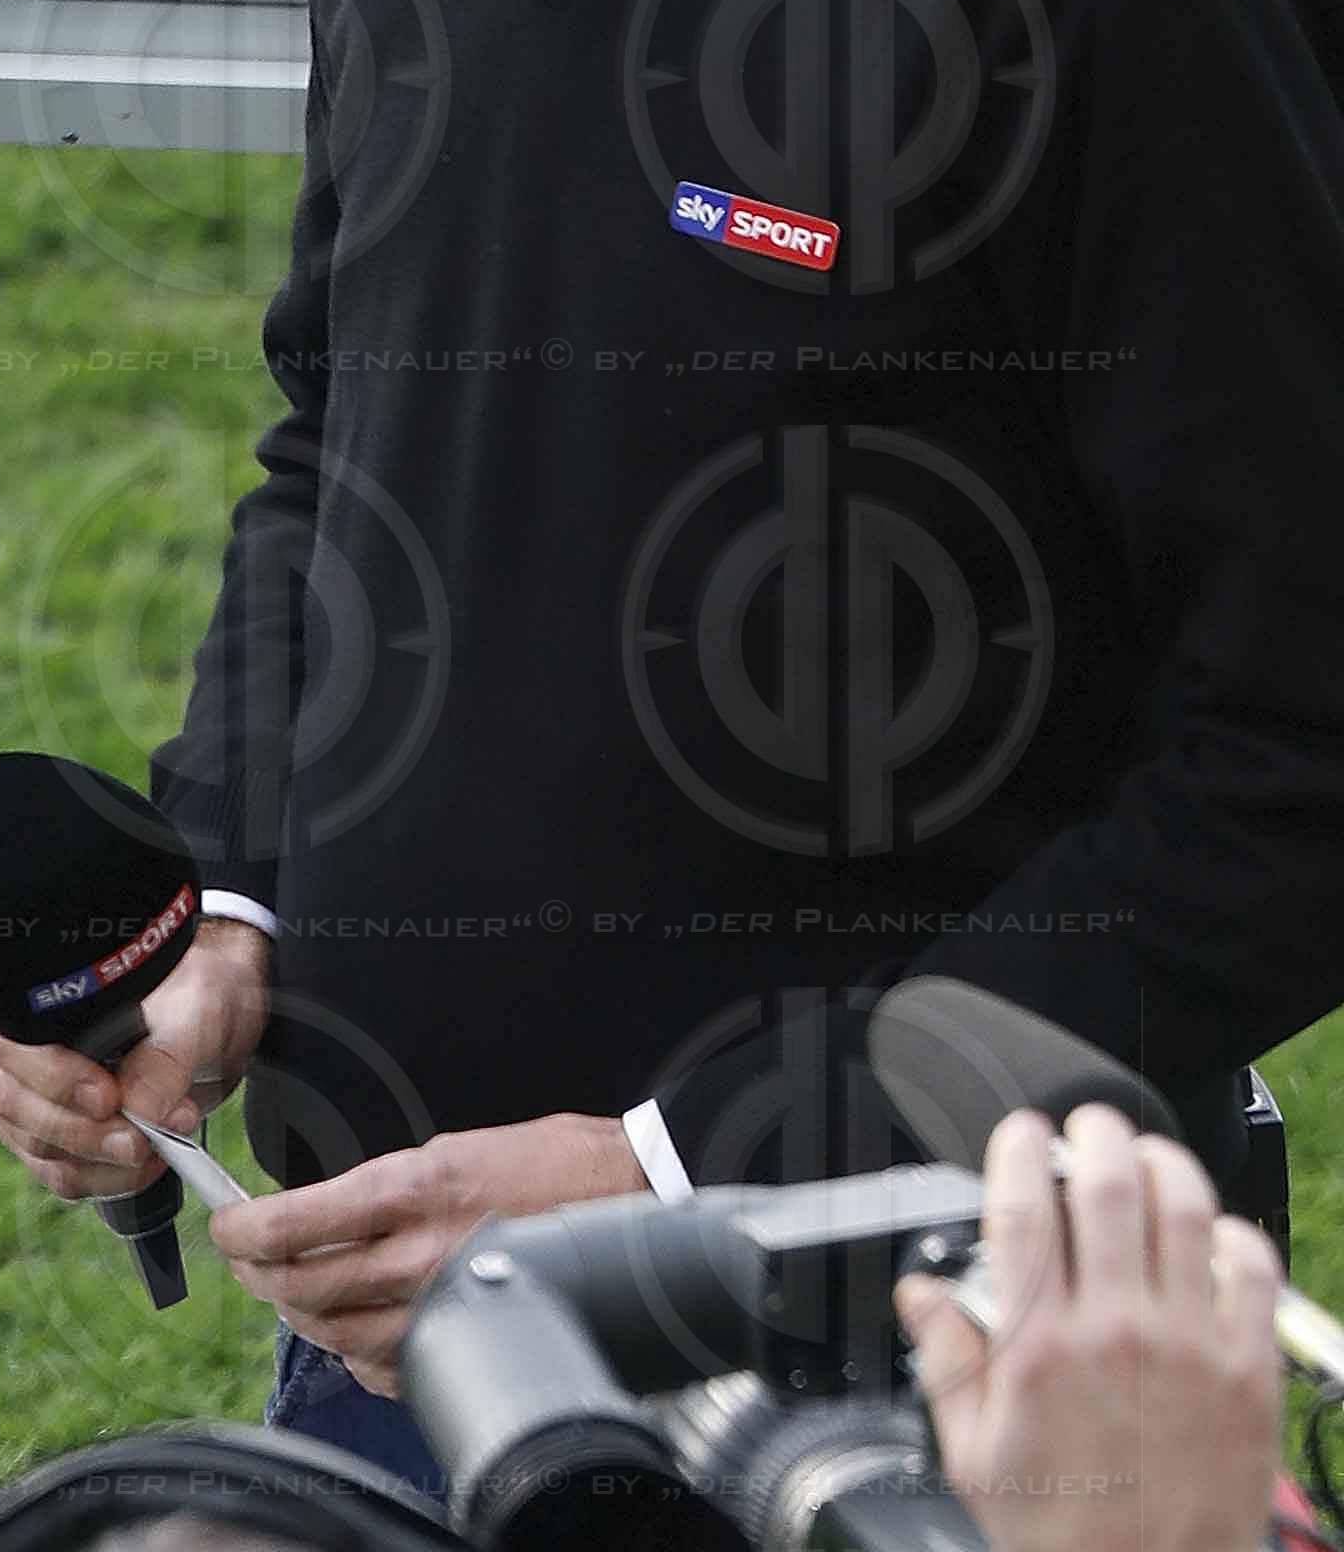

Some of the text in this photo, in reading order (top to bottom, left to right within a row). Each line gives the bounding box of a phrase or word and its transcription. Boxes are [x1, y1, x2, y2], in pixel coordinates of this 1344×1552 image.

[676, 195, 833, 258] sky SPORT
[35, 894, 189, 1006] sky SPORT
